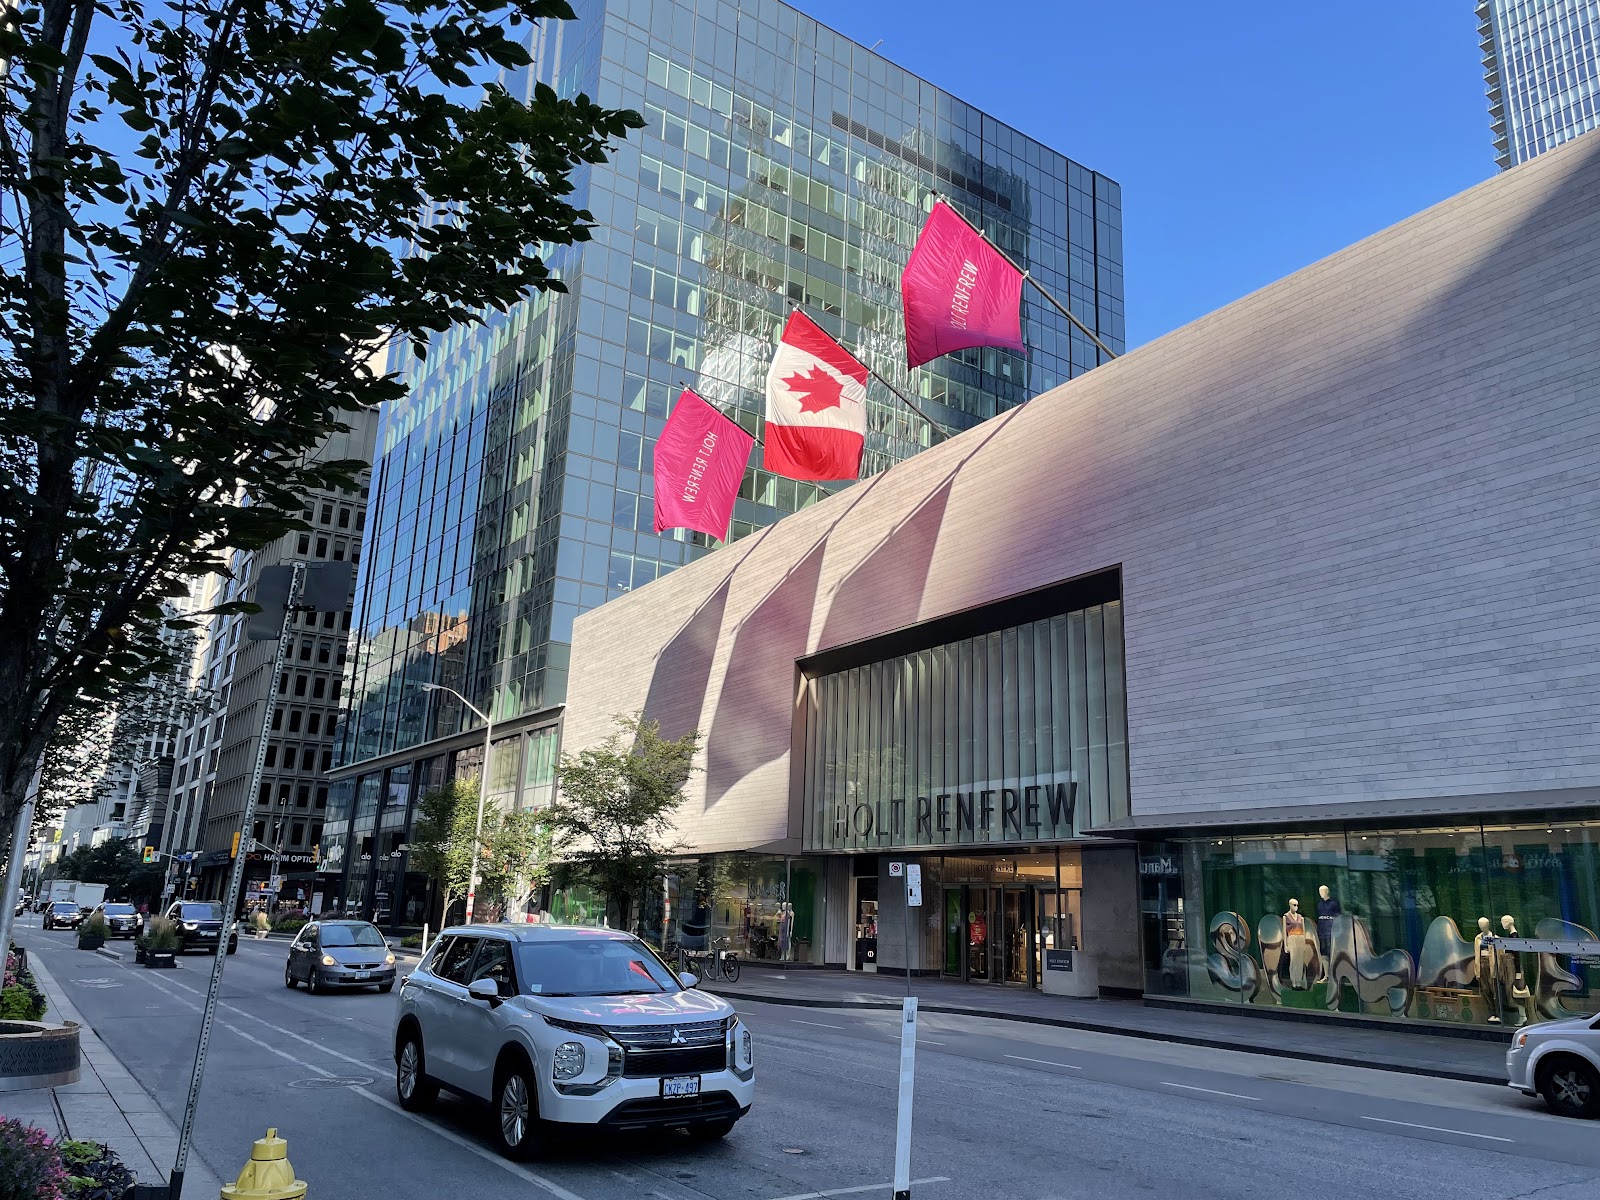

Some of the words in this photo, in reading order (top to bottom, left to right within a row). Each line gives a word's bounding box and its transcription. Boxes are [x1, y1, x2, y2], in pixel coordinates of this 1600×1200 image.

[952, 259, 978, 315] RENFREW
[834, 799, 904, 839] HOLT
[916, 782, 1078, 839] RENFREW
[264, 853, 290, 862] HAIM
[290, 855, 320, 863] OPTIC
[664, 1083, 681, 1095] CKZP
[685, 1081, 698, 1093] 497
